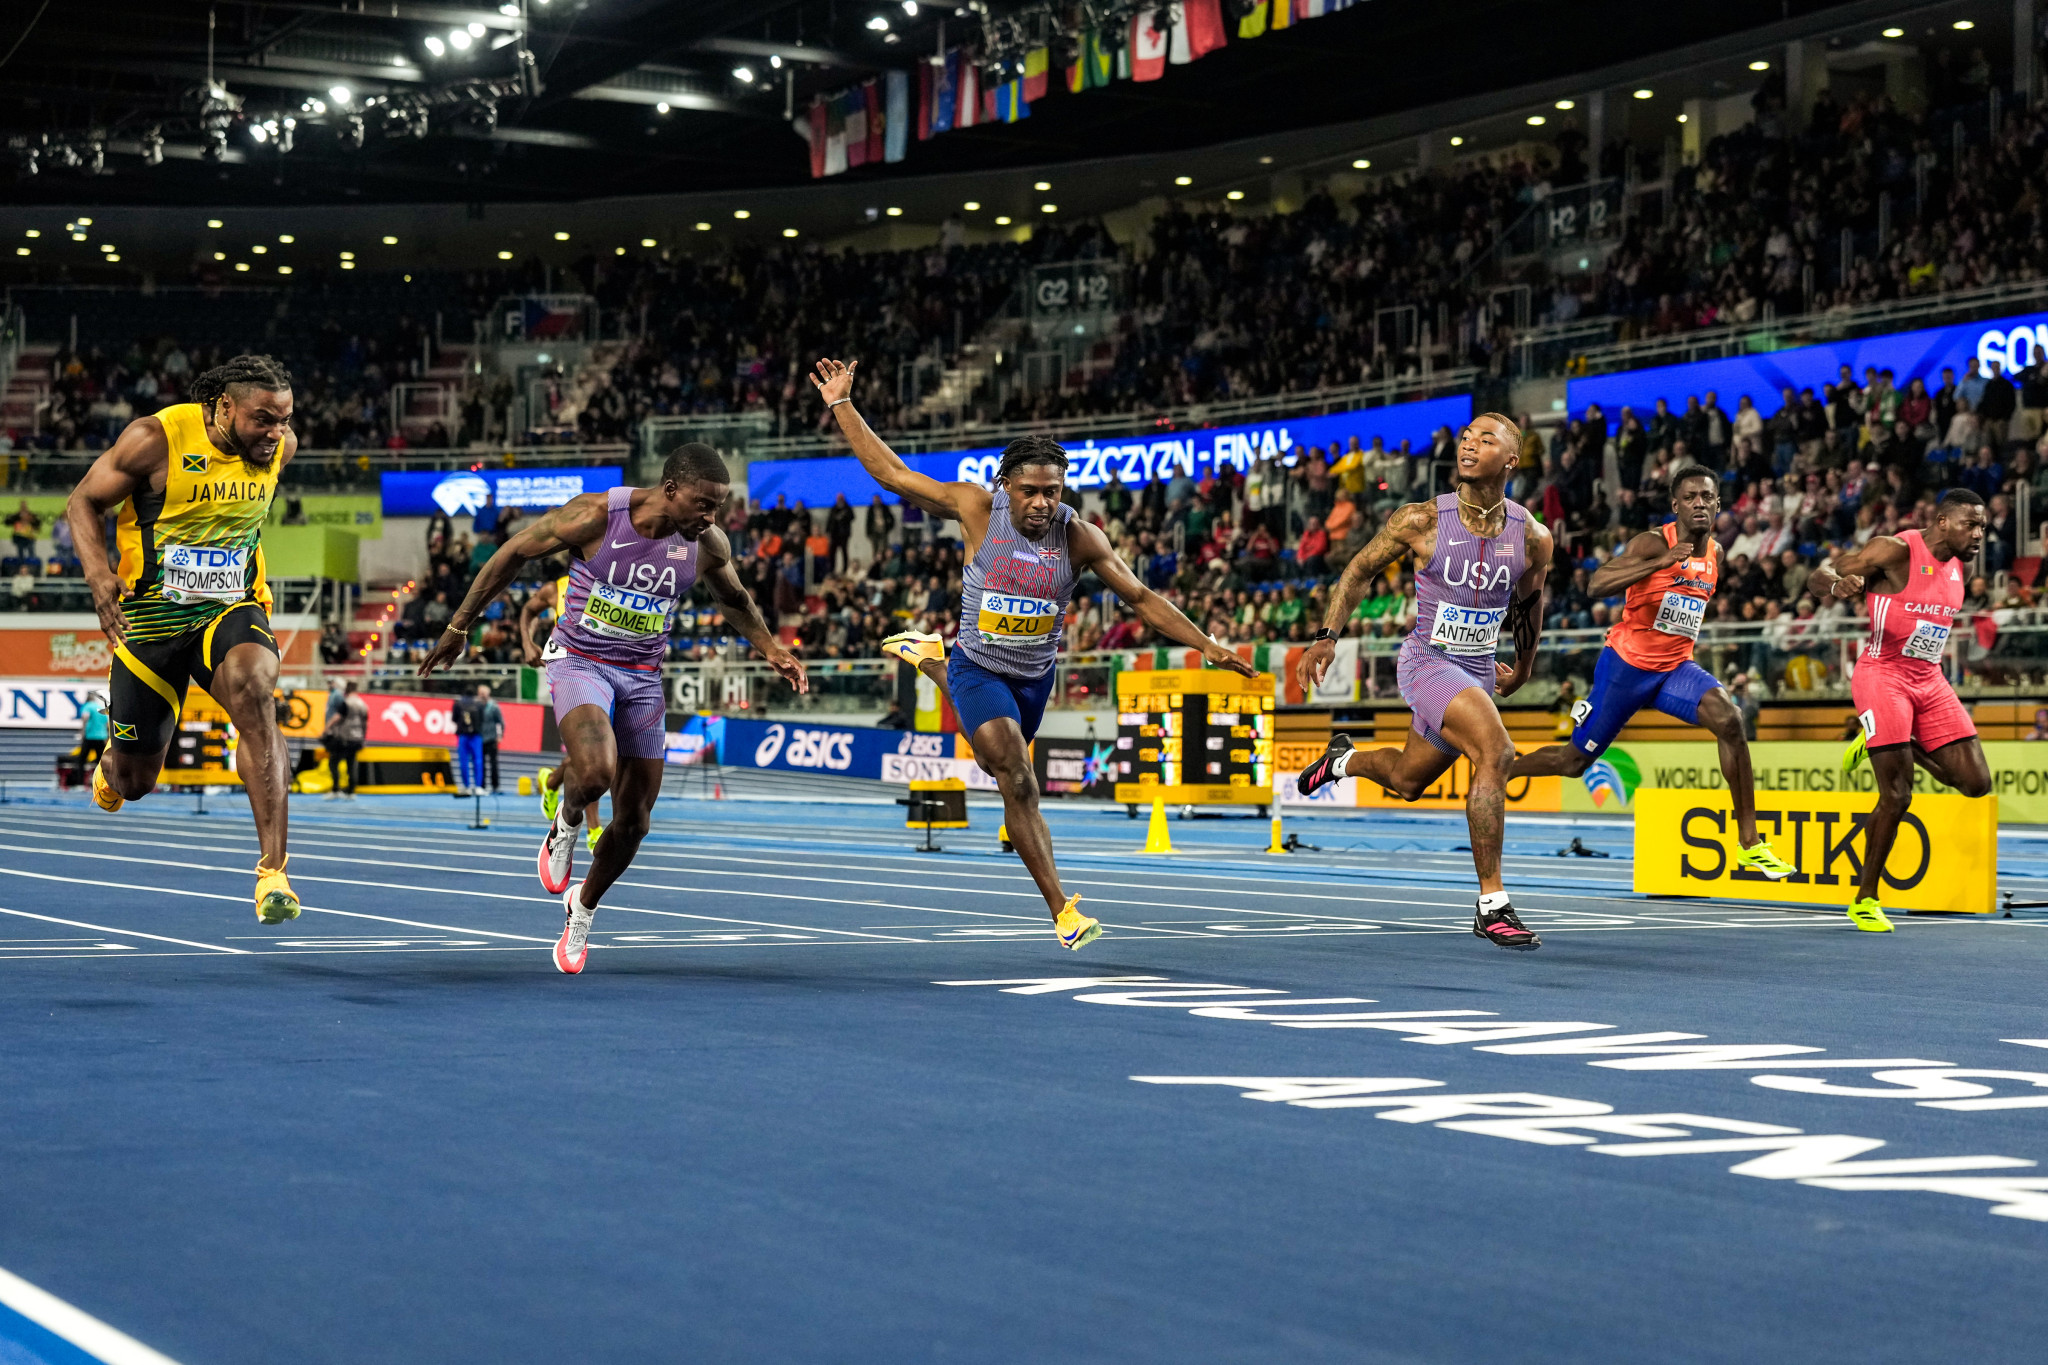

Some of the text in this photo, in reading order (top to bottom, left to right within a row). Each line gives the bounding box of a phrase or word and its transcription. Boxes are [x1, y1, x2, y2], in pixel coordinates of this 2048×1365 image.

[186, 482, 267, 503] JAMAICA
[190, 549, 243, 568] TDK
[992, 556, 1057, 585] GREAT
[168, 569, 242, 589] THOMPSON
[607, 560, 677, 596] USA
[984, 571, 1059, 600] BRITAIN
[1443, 556, 1512, 592] USA
[617, 589, 667, 614] TDK
[1003, 597, 1052, 615] TDK
[1680, 596, 1705, 614] TDK
[589, 598, 660, 634] BROMELL
[994, 616, 1040, 634] AZU
[1459, 609, 1504, 625] TDK
[1435, 622, 1498, 643] ANTHONY
[676, 674, 705, 705] G1
[0, 689, 83, 719] NY
[786, 729, 855, 770] asics
[910, 733, 944, 757] asics
[890, 760, 951, 781] SONY
[1654, 767, 1722, 790] WORLD
[1753, 768, 1834, 791] HLETICS
[1840, 768, 1924, 793] INDR
[1681, 806, 1931, 890] SEIKO
